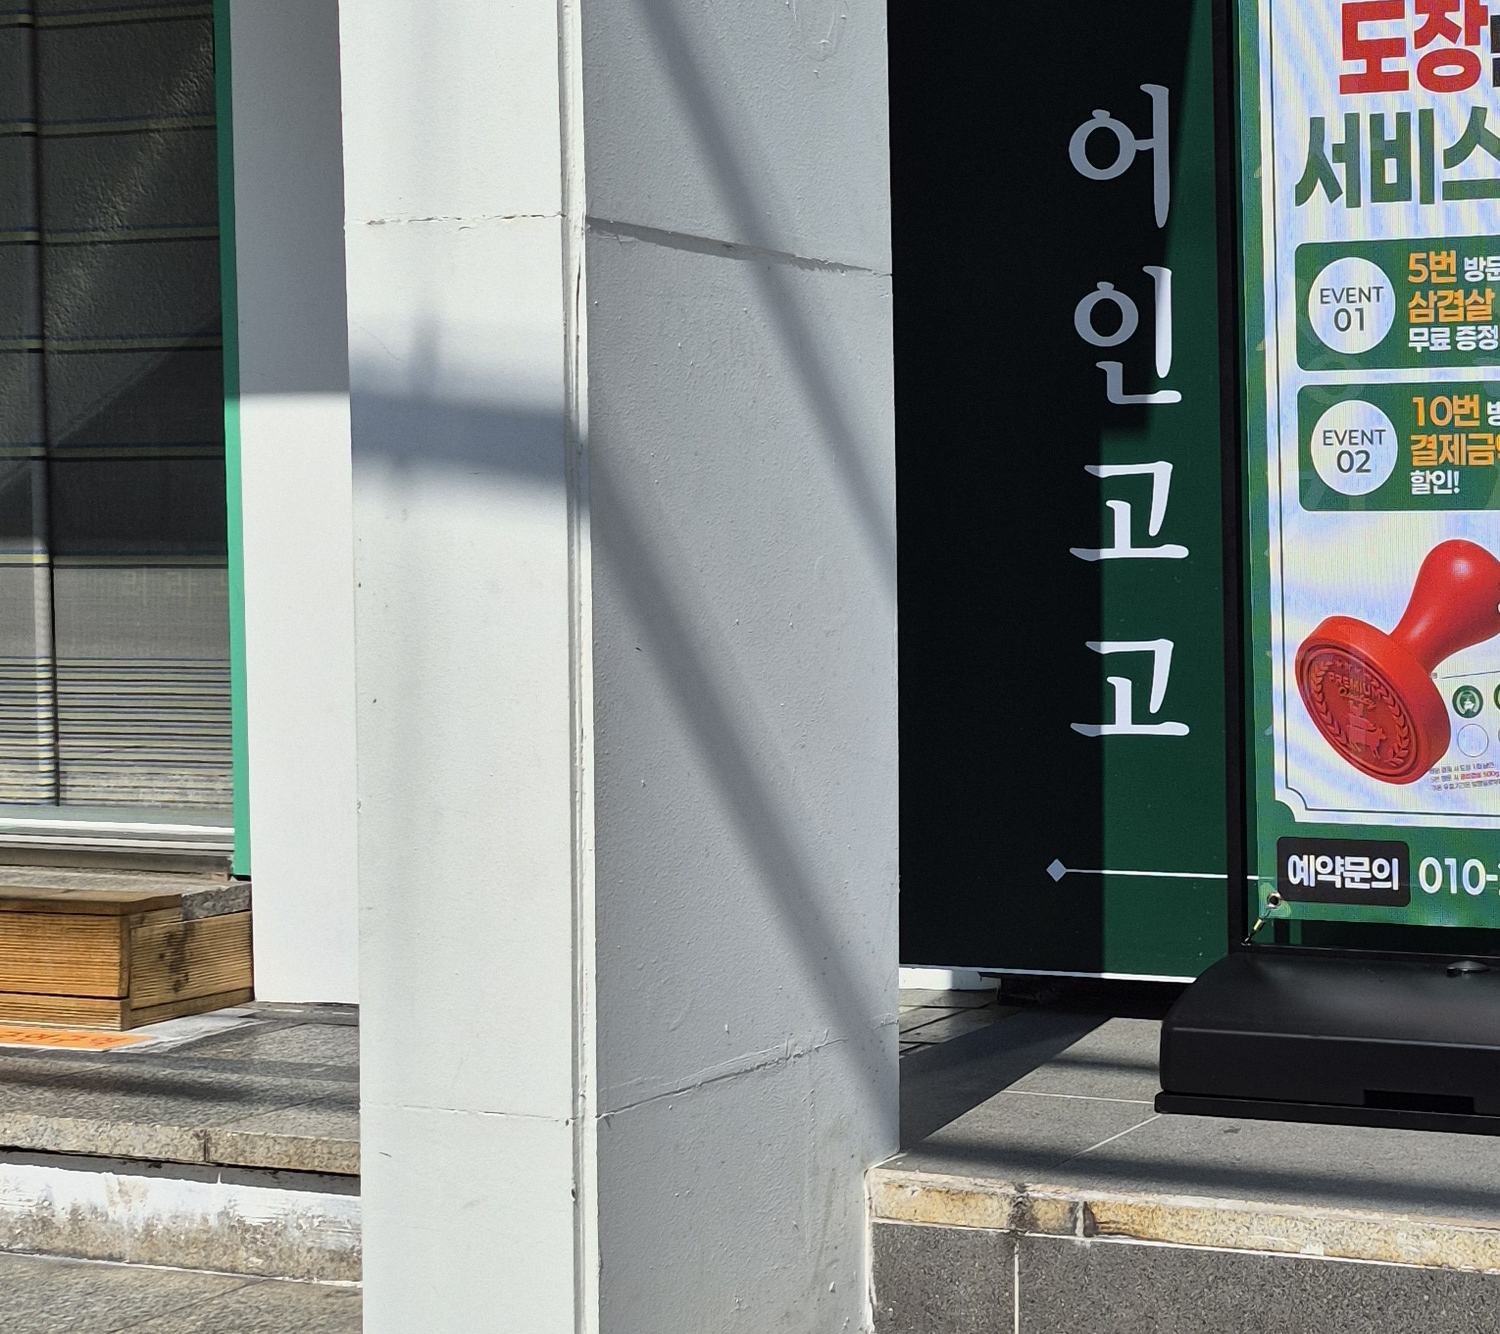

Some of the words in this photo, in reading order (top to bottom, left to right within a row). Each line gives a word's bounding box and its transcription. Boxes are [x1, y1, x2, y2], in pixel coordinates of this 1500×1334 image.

[1408, 250, 1457, 284] 5번
[1319, 286, 1385, 305] EVENT
[1408, 288, 1495, 324] 삼겹살
[1333, 307, 1365, 333] 01
[1409, 327, 1451, 353] 무료
[1412, 395, 1480, 428] 10번
[1322, 429, 1386, 446] EVENT
[1337, 450, 1371, 473] 02
[1410, 470, 1460, 495] 할인!
[1287, 854, 1399, 891] 예약문의
